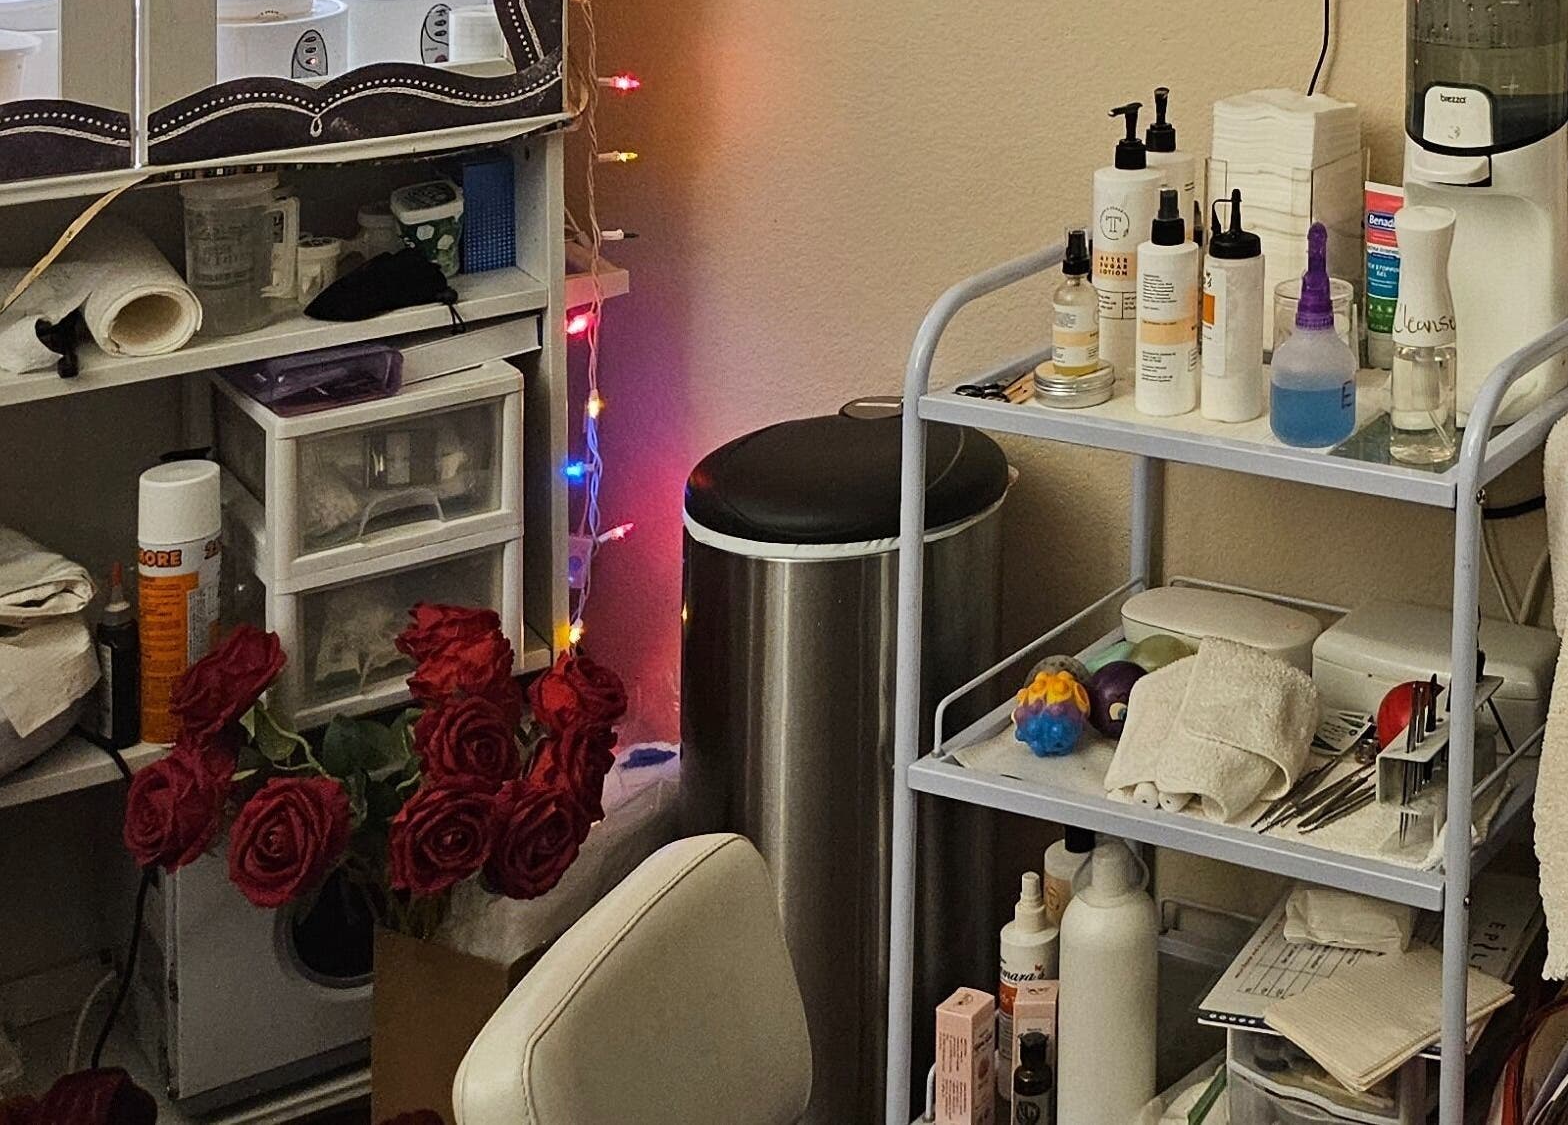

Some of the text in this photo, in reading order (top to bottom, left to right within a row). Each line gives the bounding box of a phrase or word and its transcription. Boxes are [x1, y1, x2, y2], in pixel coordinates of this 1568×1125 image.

[1369, 214, 1396, 228] Benad
[1099, 256, 1128, 264] AFTER
[1099, 262, 1128, 270] SUGAR
[1099, 268, 1128, 277] LOTION
